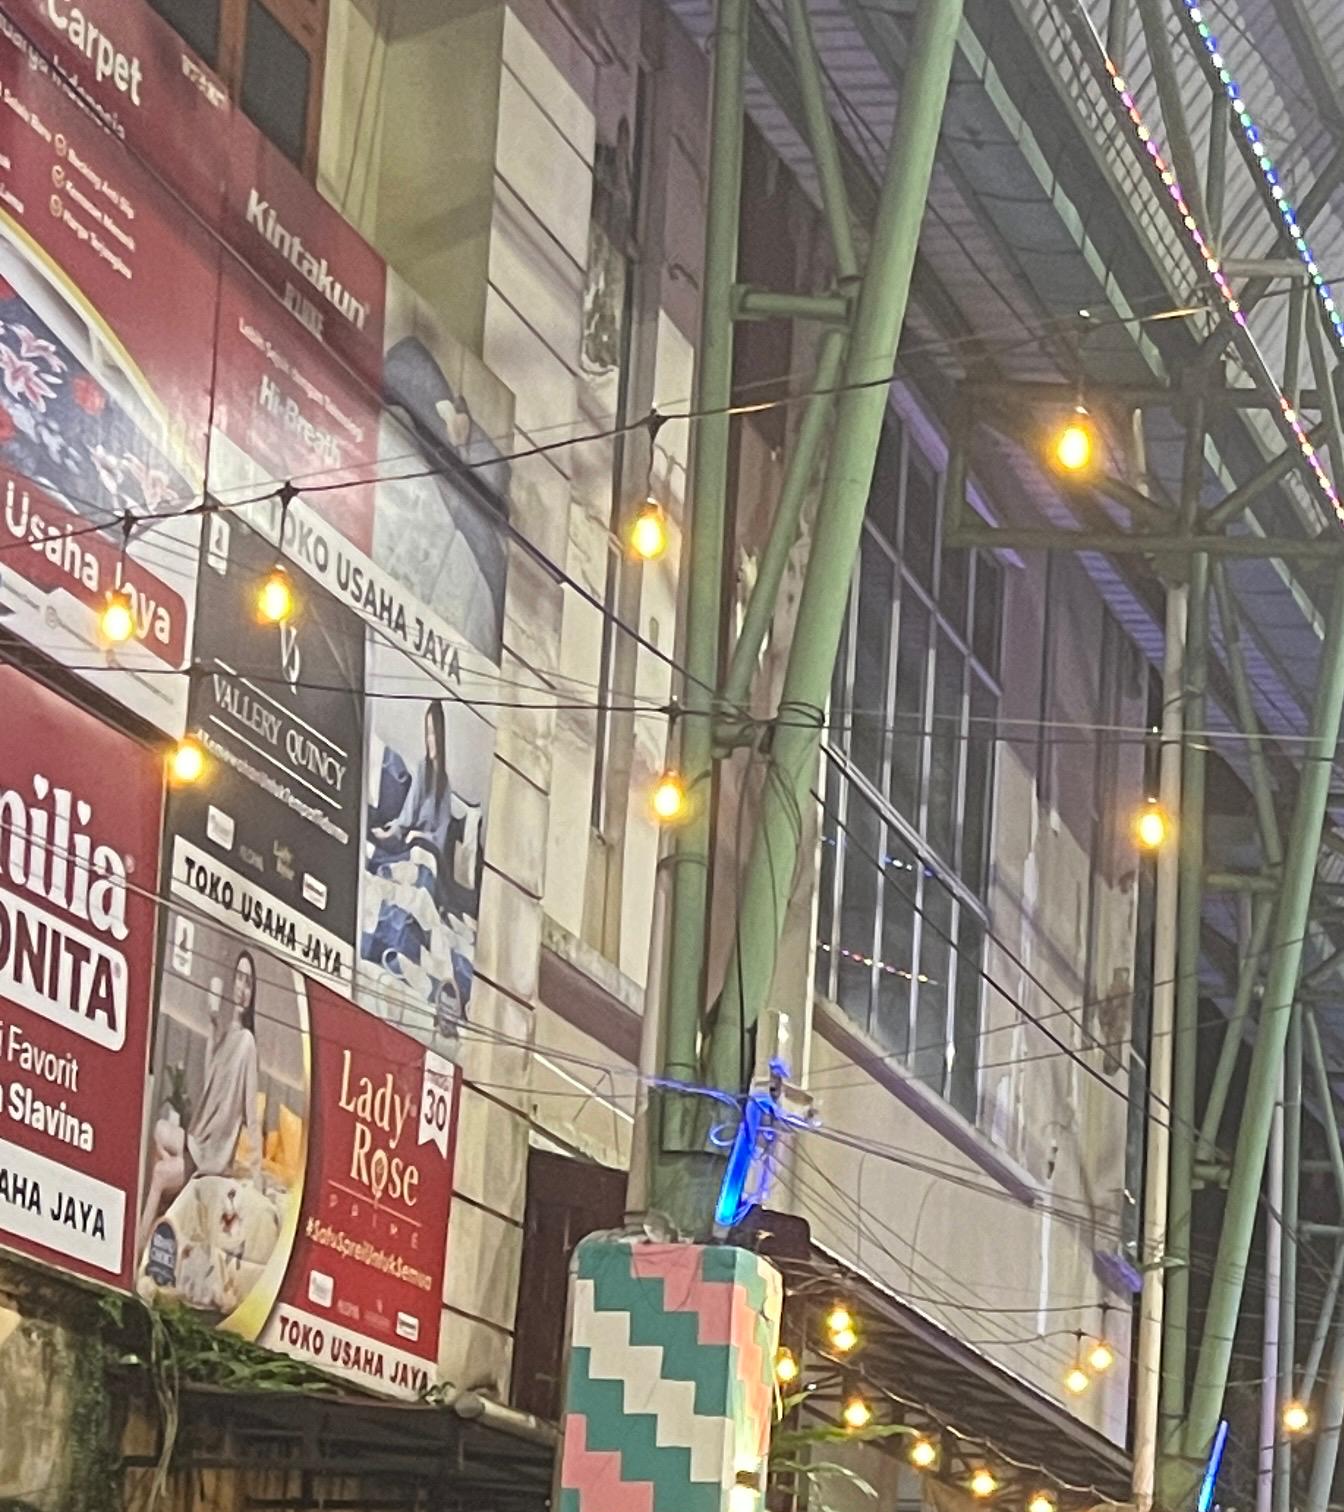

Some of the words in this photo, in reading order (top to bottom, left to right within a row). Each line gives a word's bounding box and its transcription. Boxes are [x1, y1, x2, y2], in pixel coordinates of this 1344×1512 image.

[247, 187, 366, 330] Kintakun
[5, 480, 99, 592] Usaha
[336, 552, 407, 641] USAHA
[414, 617, 461, 685] JAYA
[213, 673, 282, 745] VALLERY
[286, 729, 347, 791] QUINCY
[184, 856, 234, 911] TOKO
[242, 895, 297, 951] USAHA
[303, 934, 342, 978] JAYA
[0, 905, 118, 1033] NITA
[8, 1025, 78, 1092] Favorit
[339, 1050, 411, 1149] Lady
[9, 1082, 94, 1152] Slavina
[424, 1088, 448, 1132] 30
[351, 1123, 419, 1206] Rose
[50, 1192, 105, 1240] JAYA
[279, 1315, 324, 1352] TOKO
[331, 1335, 384, 1380] USAHA
[390, 1361, 429, 1395] JAYA
